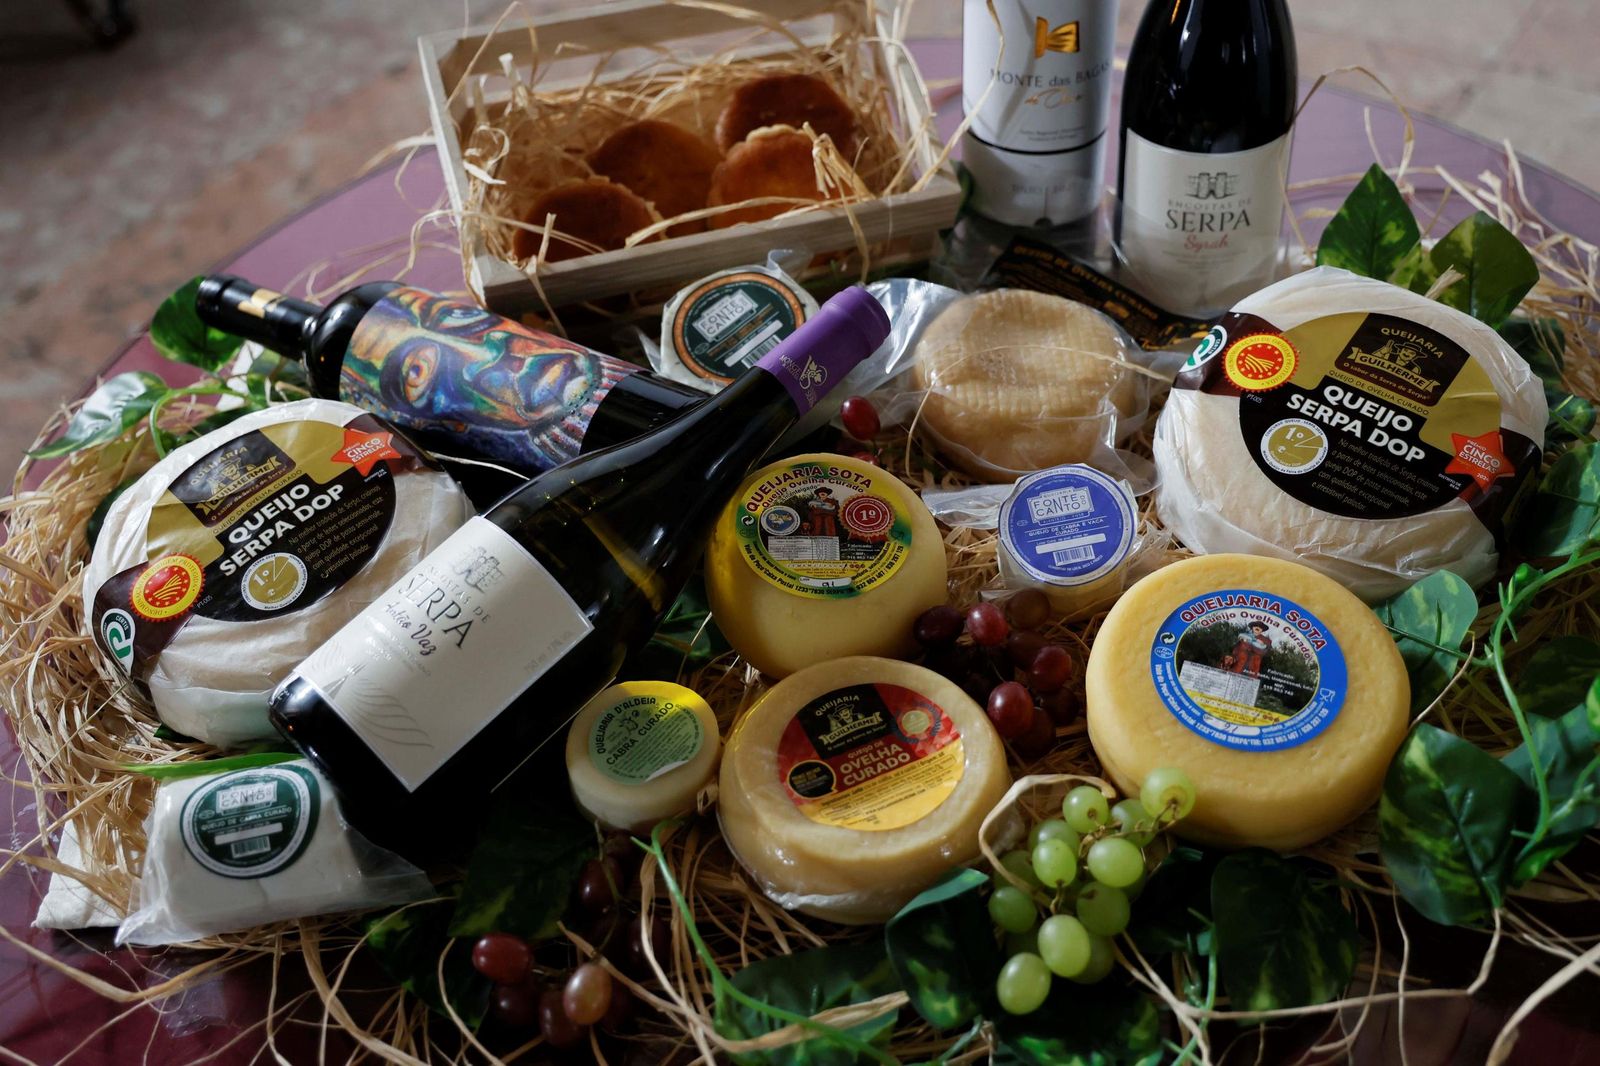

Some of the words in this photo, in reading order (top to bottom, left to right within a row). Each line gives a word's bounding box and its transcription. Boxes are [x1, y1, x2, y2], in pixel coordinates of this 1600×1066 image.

[1049, 76, 1071, 87] das
[1165, 209, 1250, 233] SERPA
[1184, 234, 1229, 253] Syrah
[701, 301, 739, 327] FONTE
[706, 306, 744, 335] CANTO
[1381, 327, 1444, 358] QUEIJARIA
[1360, 355, 1426, 387] GUILHERME
[1329, 370, 1353, 384] QUEIJO
[1356, 380, 1365, 388] DE
[1368, 385, 1395, 400] OVELHA
[1397, 398, 1429, 416] CURADO
[1323, 385, 1413, 432] QUEIJO
[1286, 393, 1362, 438] SERPA
[1367, 428, 1426, 462] DOP
[346, 437, 381, 459] CINCO
[351, 442, 386, 464] ESTRELAS
[1463, 444, 1500, 468] CINCO
[1341, 465, 1358, 479] DOP
[1459, 452, 1497, 473] ESTRELAS
[210, 465, 271, 507] GUILHERME
[746, 466, 823, 513] QUEIJARIA
[828, 467, 872, 489] SOTA
[762, 487, 787, 508] Queijo
[789, 478, 825, 488] Ovelha
[828, 478, 864, 493] Curado
[212, 516, 236, 534] QUEIJO
[236, 507, 245, 516] DE
[246, 489, 273, 508] OVELHA
[273, 470, 302, 491] CURADO
[228, 483, 310, 544] QUEIJO
[1033, 494, 1078, 512] FONTE
[1036, 501, 1081, 517] CANTO
[859, 509, 877, 521] 1º
[1061, 523, 1080, 531] CABRA
[219, 520, 296, 576] SERPA
[293, 484, 344, 522] DOP
[1055, 528, 1079, 536] CURADO
[318, 538, 334, 551] DOP
[398, 573, 474, 650] SERPA
[473, 606, 491, 624] DE
[1180, 594, 1282, 623] QUEIJARIA
[1285, 610, 1327, 651] SOTA
[1200, 612, 1236, 628] Queijo
[1240, 611, 1280, 628] Ovelha
[411, 623, 437, 656] Vaz
[815, 695, 860, 717] QUEIJARIA
[595, 713, 615, 755] QUEIJARIA
[614, 697, 656, 714] D'ALDEIA
[606, 738, 640, 766] CABRA
[638, 702, 674, 736] CURADO
[828, 717, 876, 740] GUILHERME
[840, 743, 903, 774] OVELHA
[847, 745, 873, 758] QUEIJO
[843, 752, 911, 787] CURADO
[240, 814, 262, 822] CABRA
[264, 807, 292, 817] CURADO
